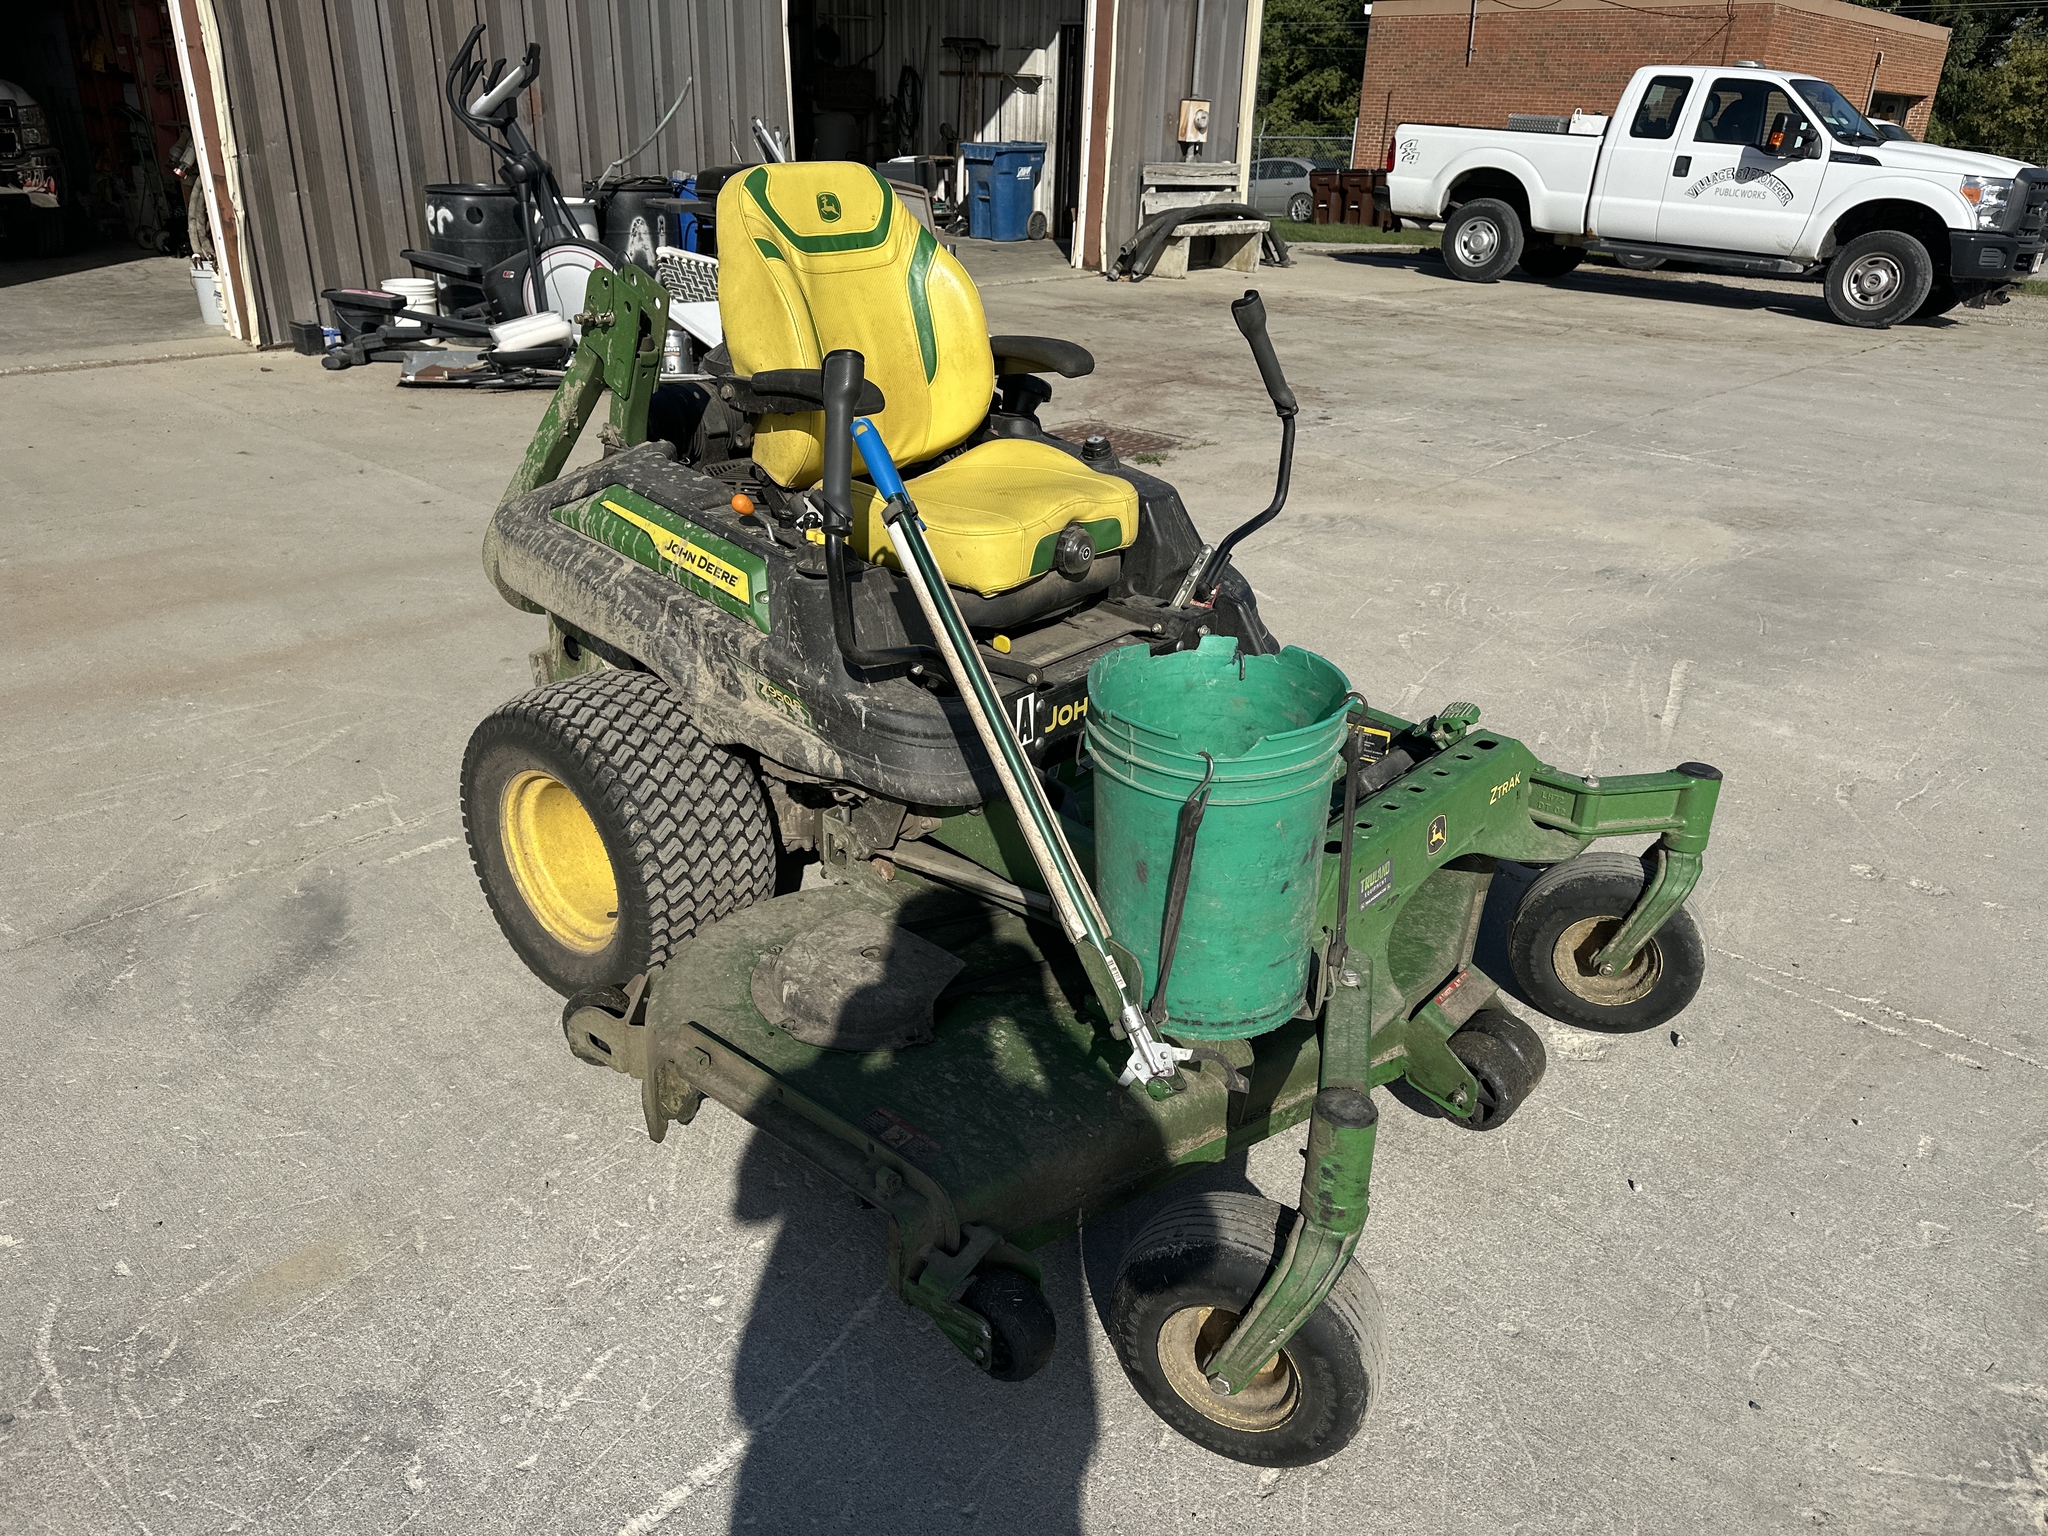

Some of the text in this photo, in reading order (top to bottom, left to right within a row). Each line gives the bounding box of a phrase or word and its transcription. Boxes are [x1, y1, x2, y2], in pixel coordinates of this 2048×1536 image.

[1685, 167, 1735, 199] VILLAGE
[1750, 167, 1794, 206] PIONEER
[1714, 187, 1767, 200] PUBLIC WORKS
[665, 540, 739, 588] JOHN DEERE
[1044, 696, 1089, 734] JOH
[1489, 770, 1522, 806] ZTRAK
